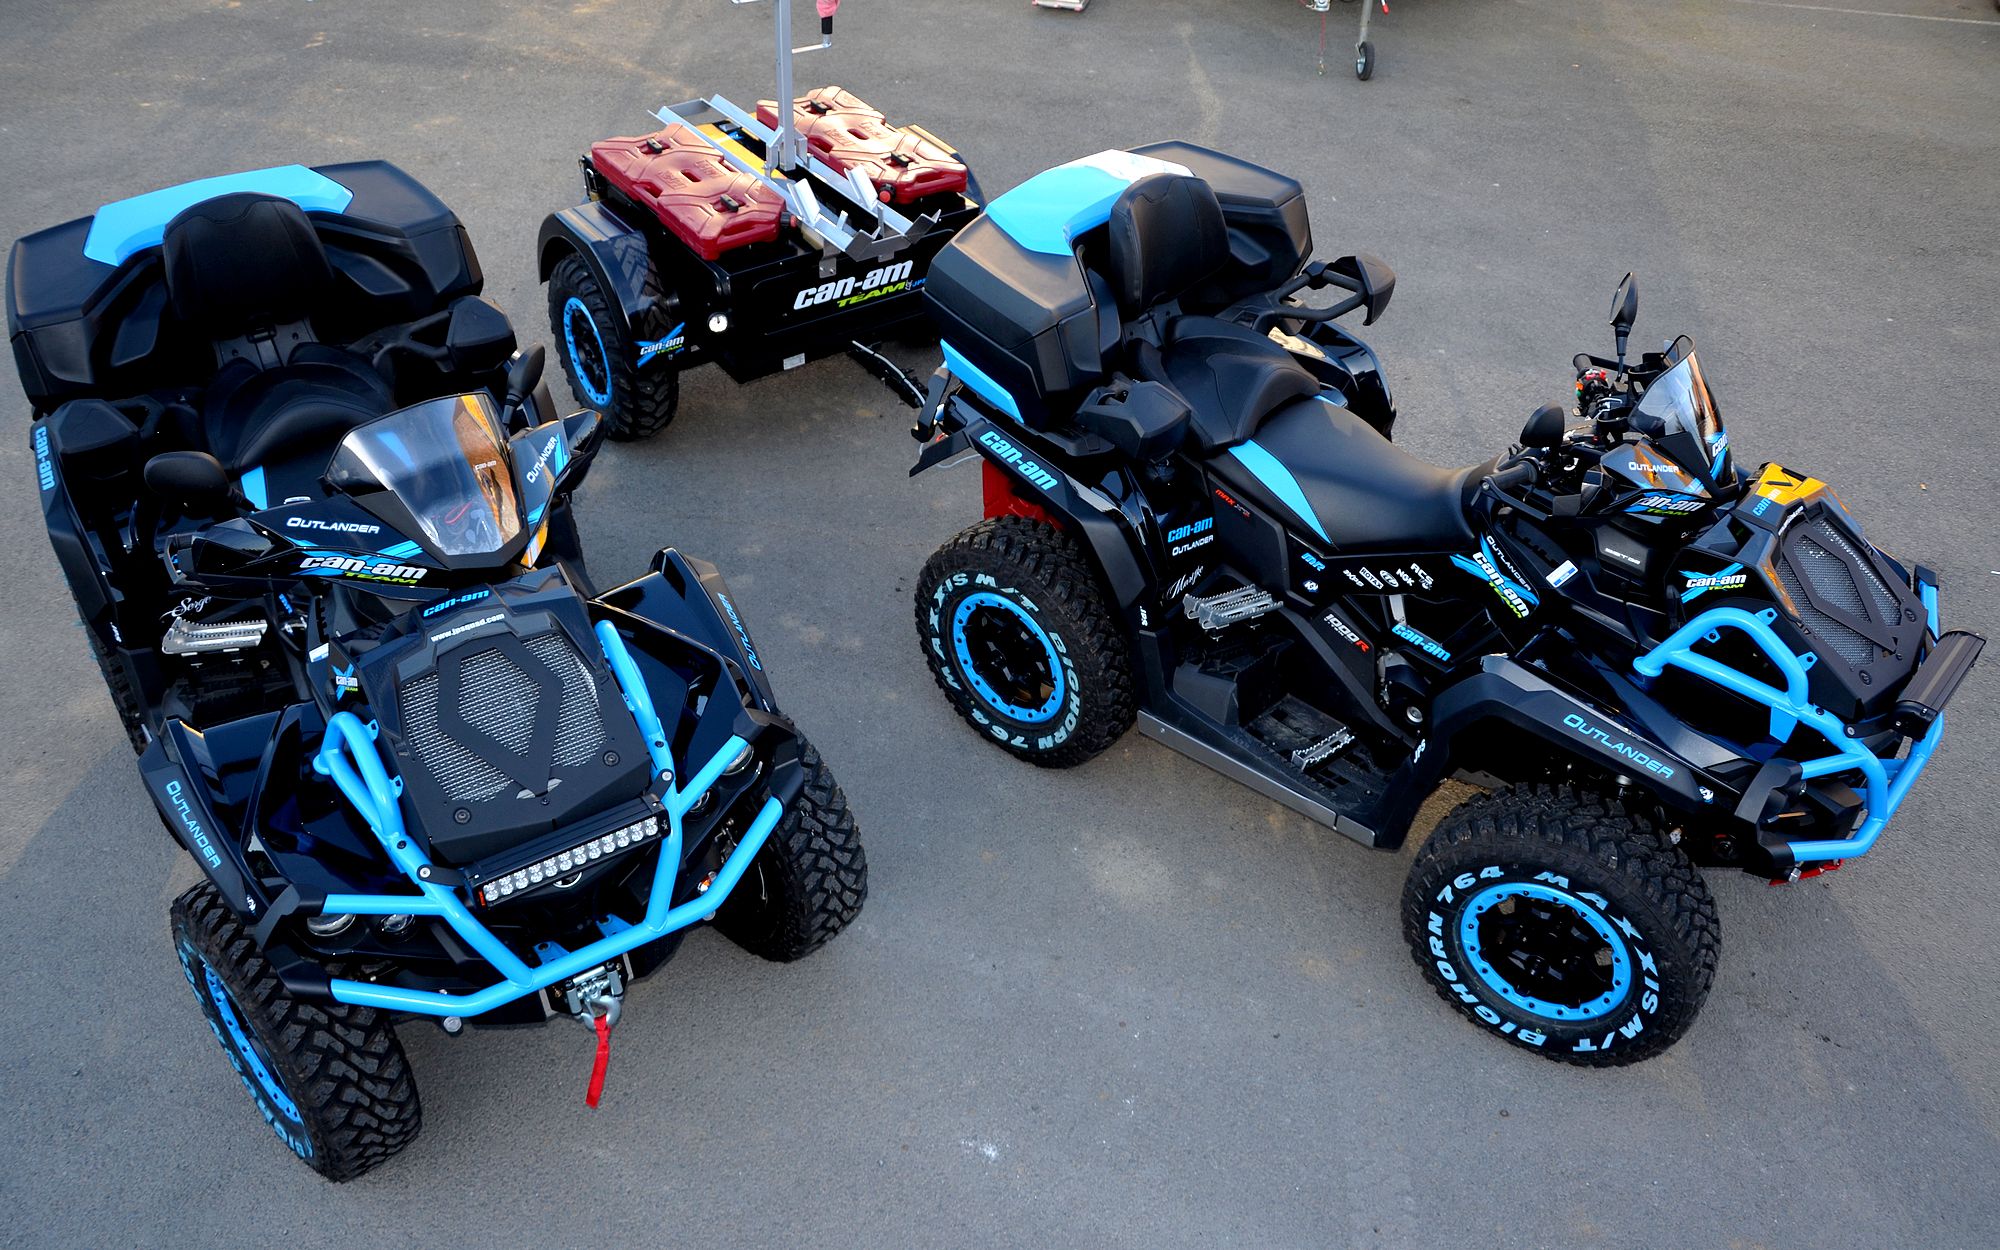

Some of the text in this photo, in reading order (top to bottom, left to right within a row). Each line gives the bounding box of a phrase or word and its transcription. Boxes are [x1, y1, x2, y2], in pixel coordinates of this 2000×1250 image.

[793, 260, 914, 310] can-am
[836, 281, 906, 308] TEAM
[639, 335, 685, 355] can-am
[35, 426, 56, 491] can-am
[980, 430, 1058, 491] can-am
[1167, 517, 1214, 543] can-am
[299, 556, 428, 579] can-am
[343, 571, 418, 584] TEAM
[1395, 568, 1415, 586] NGK
[1472, 551, 1530, 618] can-am
[1686, 574, 1747, 588] can-am
[423, 589, 490, 618] can-am
[929, 573, 969, 691] MAXXIS
[1391, 623, 1452, 662] can-am
[971, 631, 1081, 750] BIGHORN 764
[1563, 713, 1675, 779] OUTLANDER
[165, 780, 222, 869] OUTLANDER
[1427, 865, 1548, 1047] BIGHORN 764
[1533, 870, 1660, 1052] MAXXIS M/T
